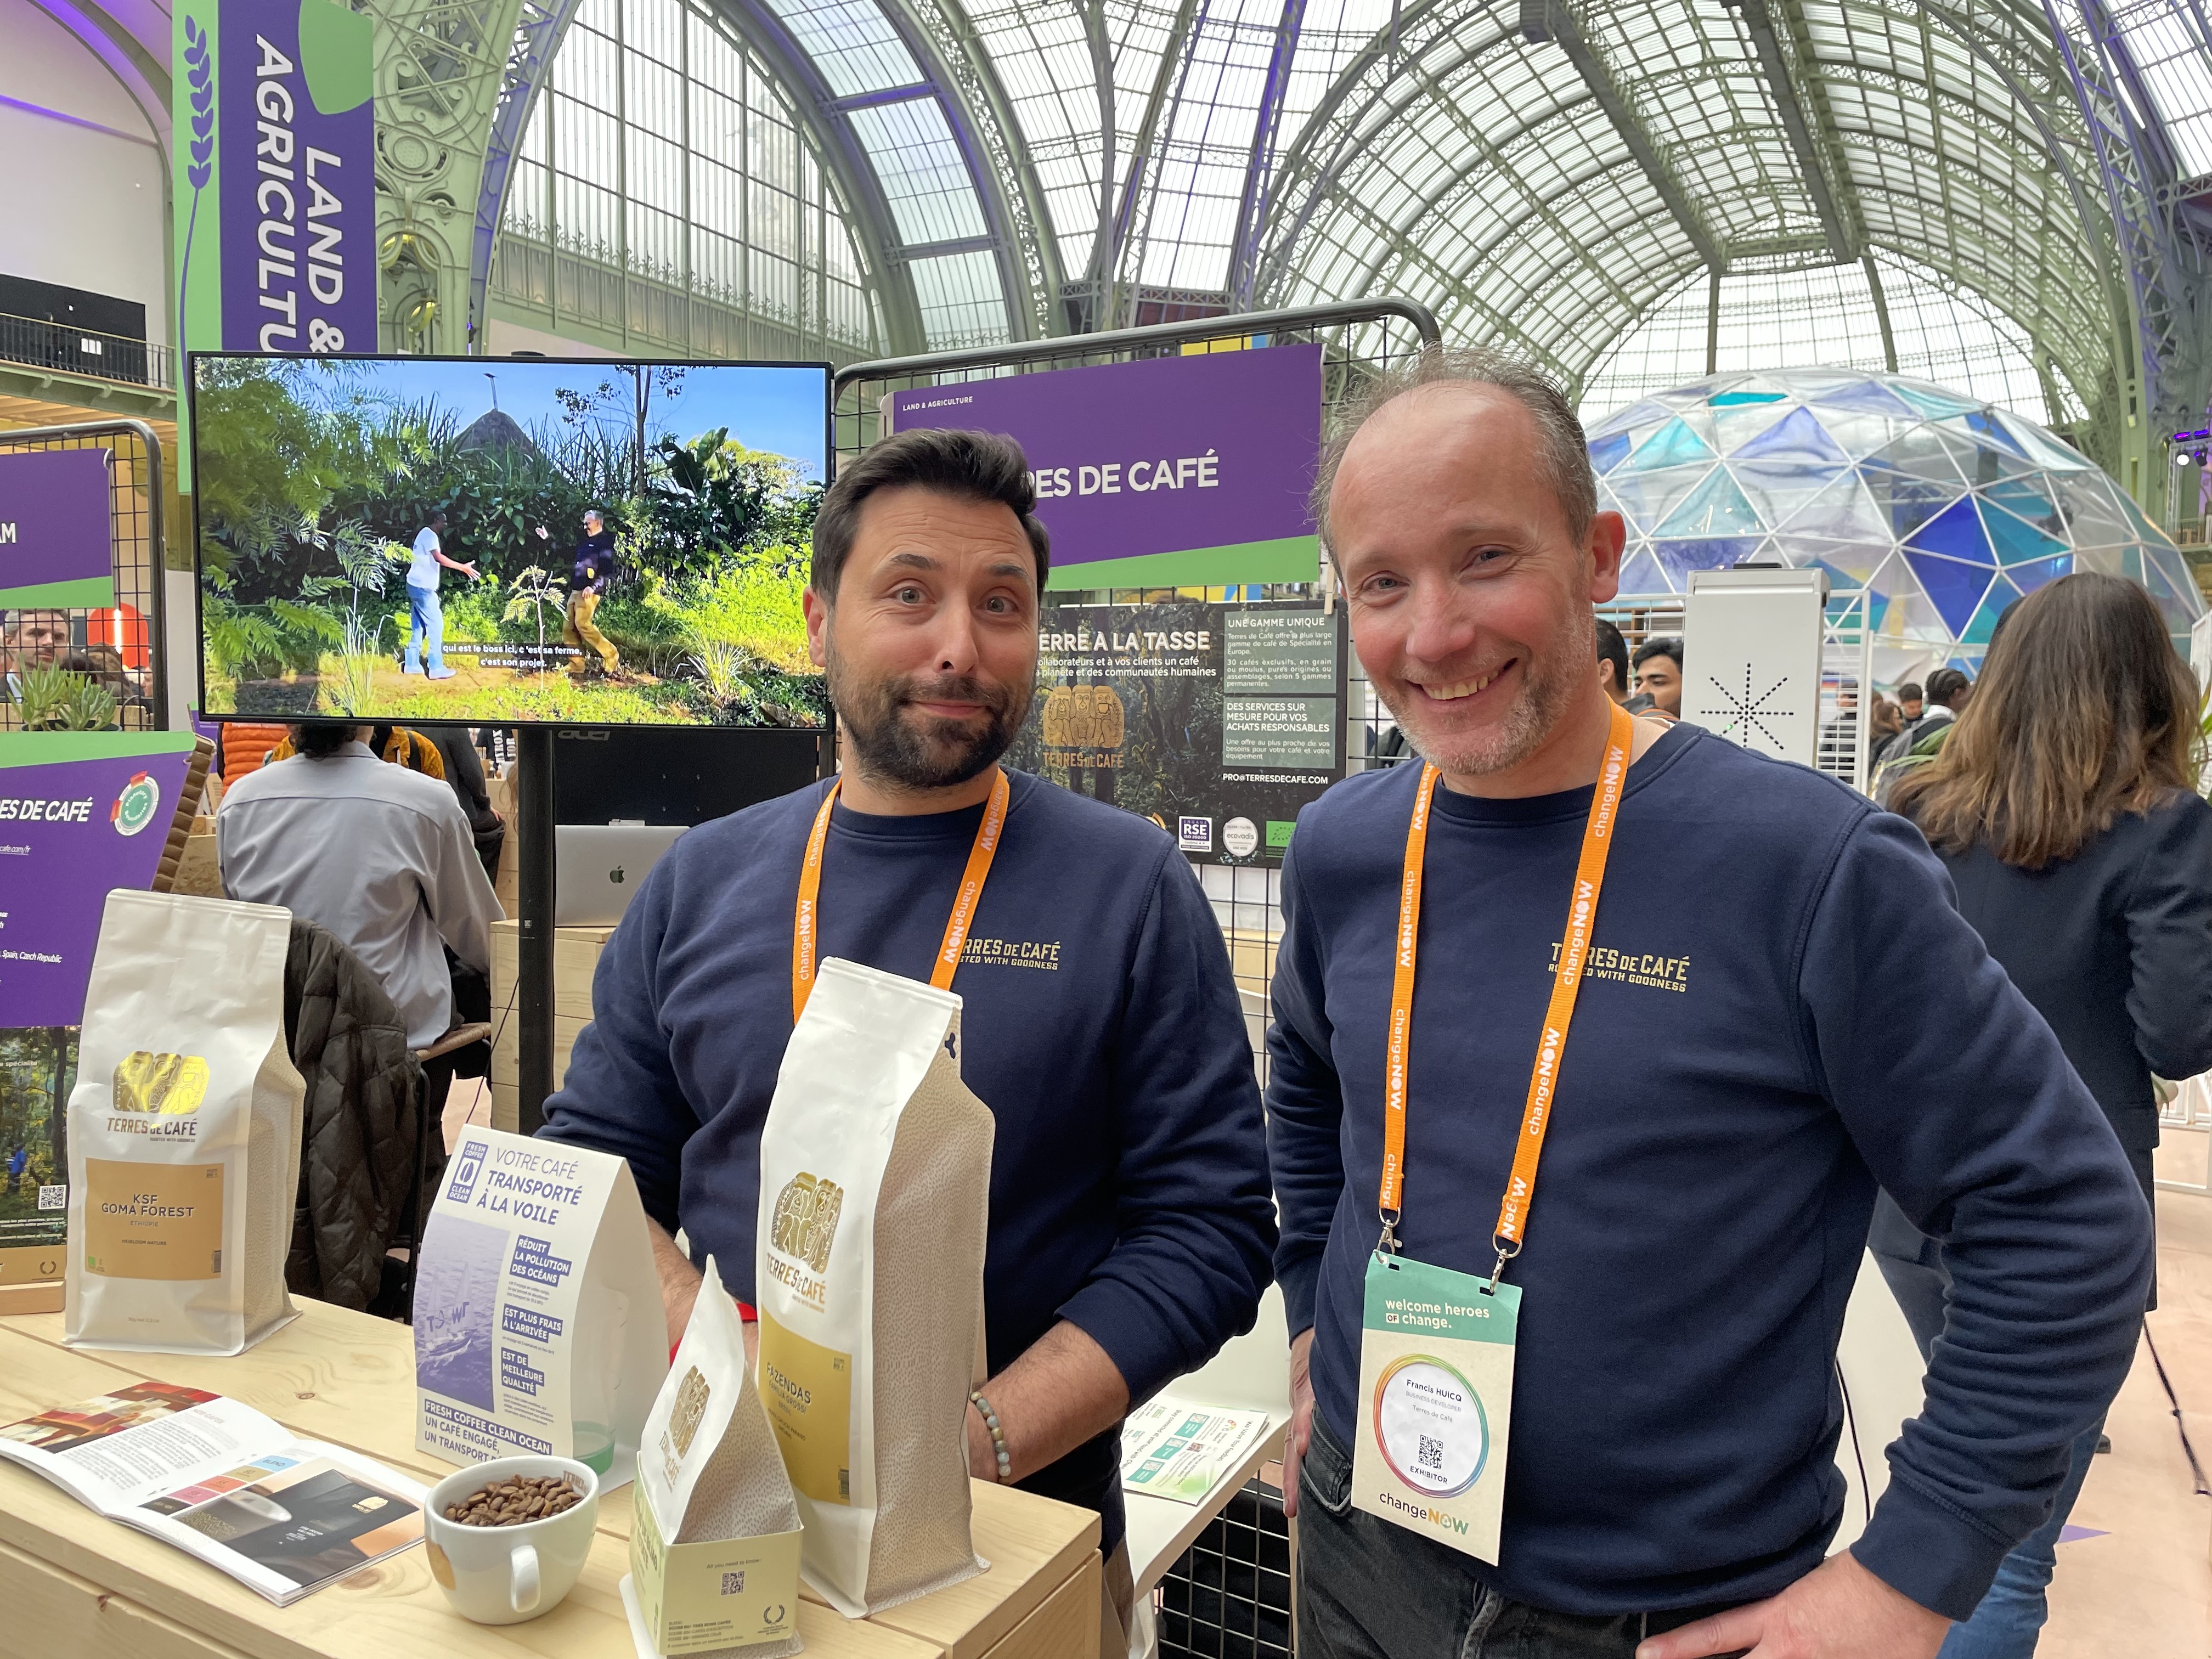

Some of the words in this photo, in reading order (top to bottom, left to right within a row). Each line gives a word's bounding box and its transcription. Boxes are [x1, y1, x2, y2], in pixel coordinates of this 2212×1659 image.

[306, 146, 343, 305] LAND
[903, 402, 920, 411] LAND
[928, 396, 973, 408] AGRICULTURE
[1079, 464, 1121, 495] DE
[1128, 448, 1219, 492] CAFÉ
[1228, 619, 1248, 628] UNE
[1250, 618, 1284, 627] GAMME
[1287, 617, 1324, 628] UNIQUE
[443, 644, 456, 653] qui
[554, 646, 582, 656] ferme,
[1093, 631, 1109, 651] À
[1113, 632, 1139, 651] LA
[1143, 631, 1210, 651] TASSE
[520, 659, 547, 668] projet.
[1108, 657, 1113, 666] à
[1133, 657, 1163, 665] clients
[1179, 656, 1199, 665] café
[1042, 668, 1074, 679] planète
[1087, 668, 1103, 676] des
[1105, 667, 1168, 676] communautés
[1171, 667, 1216, 676] humaines
[1227, 713, 1262, 721] MESURE
[1289, 713, 1307, 721] VOS
[1245, 703, 1285, 711] SERVICES
[1261, 723, 1330, 732] RESPONSABLES
[1043, 752, 1084, 768] TERRES
[1097, 751, 1124, 768] CAFÉ
[1222, 773, 1328, 784] PRO@TERRESDECAFE.COM
[1594, 744, 1624, 838] changeNOW
[19, 800, 46, 820] DE
[45, 797, 93, 822] CAFÉ
[980, 784, 1004, 851] changeNOW
[1183, 824, 1207, 835] RSE
[944, 881, 975, 964] changeNOW
[1400, 871, 1414, 967] changeNOW
[798, 900, 812, 981] changeNOW
[1563, 879, 1593, 985] changeNOW
[19, 951, 37, 961] Czech
[37, 953, 63, 963] Republic
[1003, 944, 1019, 956] DE
[1021, 941, 1060, 961] CAFÉ
[984, 956, 1008, 965] WITH
[1011, 958, 1058, 970] GOODNESS
[1620, 955, 1639, 972] DE
[1640, 954, 1690, 981] CAFÉ
[1597, 969, 1626, 981] WITH
[1628, 974, 1686, 992] GOODNESS
[1390, 1008, 1404, 1111] changeNOW
[1528, 1027, 1560, 1135] changeNOW
[107, 1118, 148, 1134] TERRES
[165, 1118, 198, 1136] CAFÉ
[465, 1150, 484, 1159] COFFEE
[466, 1143, 486, 1153] FRESH
[496, 1147, 540, 1171] VOTRE
[541, 1160, 579, 1180] CAFÉ
[449, 1192, 468, 1201] OCEAN
[451, 1186, 470, 1195] CLEAN
[487, 1170, 583, 1205] TRANSPORTÉ
[133, 1193, 158, 1205] KSF
[476, 1188, 489, 1209] À
[490, 1195, 508, 1214] LA
[514, 1200, 559, 1226] VOILE
[101, 1203, 137, 1215] GOMA
[141, 1206, 195, 1217] FOREST
[518, 1238, 547, 1253] RÉDUIT
[515, 1251, 524, 1261] LA
[526, 1254, 569, 1273] POLLUTION
[512, 1263, 526, 1275] DES
[527, 1268, 557, 1283] OCÉANS
[767, 1252, 800, 1288] TERRES
[801, 1276, 826, 1304] CAFÉ
[1385, 1299, 1441, 1313] welcome
[1445, 1302, 1489, 1318] heroes
[503, 1317, 509, 1328] À
[510, 1323, 548, 1340] L'ARRIVÉE
[505, 1307, 518, 1318] EST
[519, 1312, 538, 1324] PLUS
[539, 1318, 562, 1331] FRAIS
[1402, 1313, 1452, 1329] change.
[503, 1351, 516, 1362] EST
[517, 1356, 527, 1365] DE
[503, 1363, 543, 1383] MEILLEURE
[767, 1361, 811, 1404] FAZENDAS
[503, 1375, 534, 1393] QUALITÉ
[1407, 1379, 1434, 1393] Francis
[1436, 1388, 1462, 1402] HUICQ
[1406, 1391, 1430, 1403] BUSINESS
[1431, 1400, 1462, 1413] DEVELOPER
[1413, 1405, 1430, 1415] Terres
[1440, 1414, 1453, 1423] Café
[425, 1401, 452, 1419] FRESH
[454, 1412, 486, 1432] COFFEE
[488, 1424, 517, 1443] CLEAN
[518, 1435, 550, 1455] OCEAN
[425, 1415, 438, 1427] UN
[439, 1421, 461, 1437] CAFÉ
[463, 1430, 499, 1454] ENGAGÉ,
[425, 1430, 437, 1443] UN
[438, 1436, 489, 1463] TRANSPORT
[1410, 1466, 1447, 1484] EXHIBITOR
[1379, 1493, 1469, 1535] changeNOW
